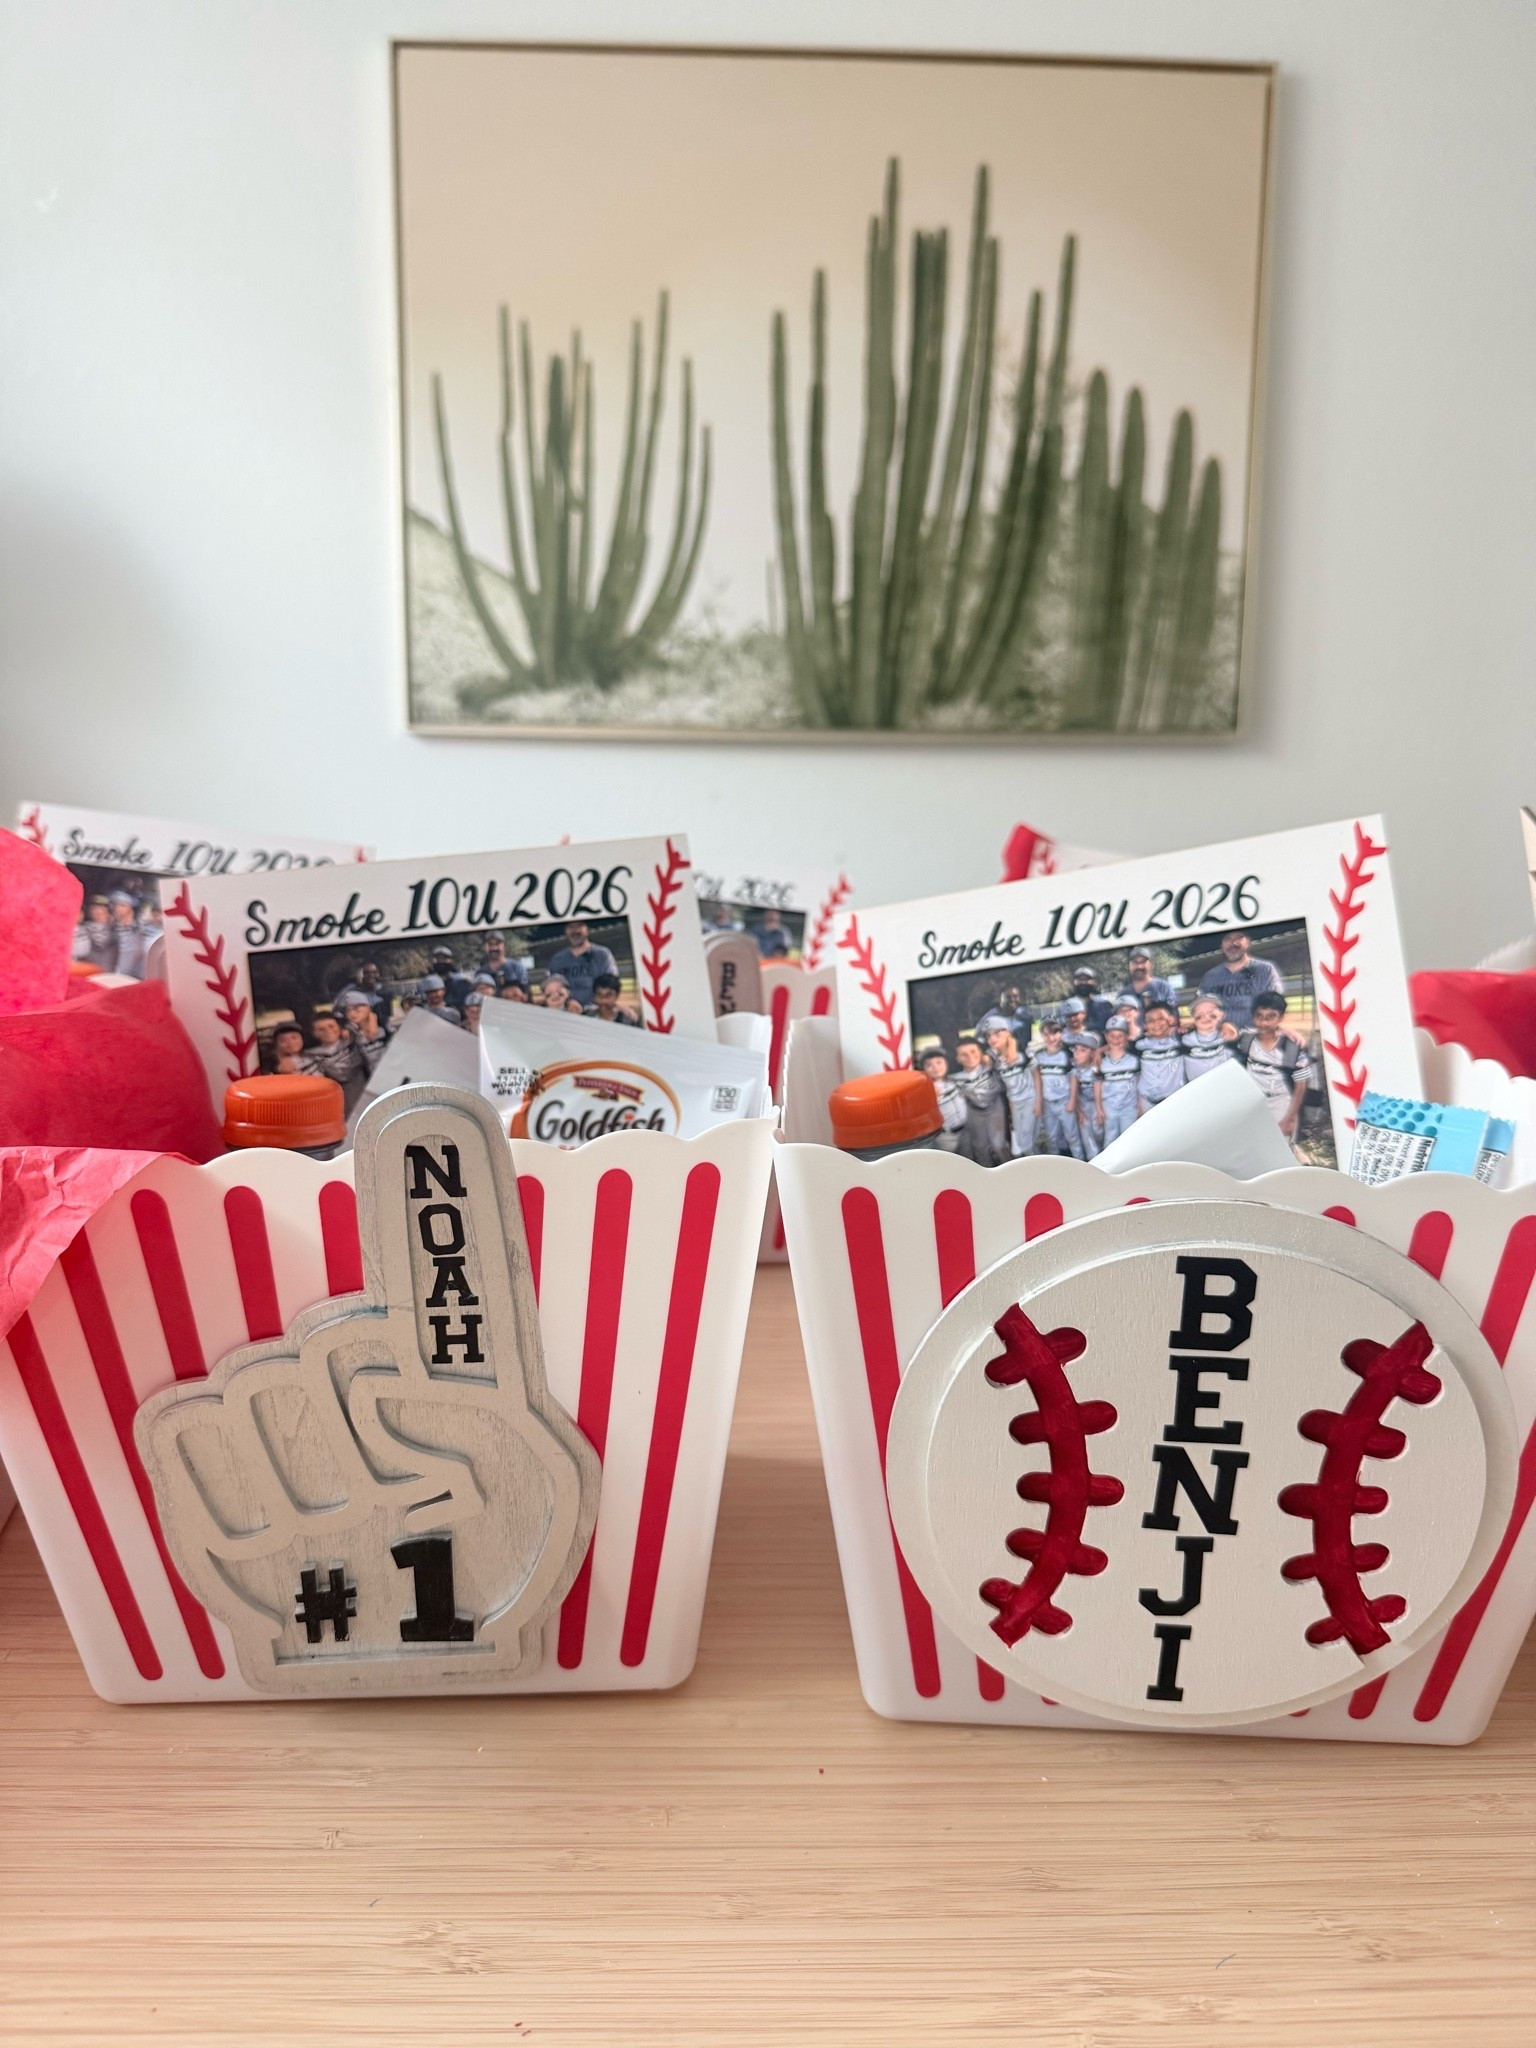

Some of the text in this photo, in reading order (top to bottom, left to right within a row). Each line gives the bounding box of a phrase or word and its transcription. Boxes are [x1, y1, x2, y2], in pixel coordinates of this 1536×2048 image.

[62, 828, 153, 866] Smoke
[245, 892, 390, 948] Smoke
[401, 877, 499, 932] 10U
[508, 865, 632, 922] 2026
[919, 875, 1259, 967] Smoke 10U 2026
[535, 1099, 665, 1141] Goldfish
[405, 1144, 485, 1365] NOAH
[1139, 1255, 1258, 1702] BENJI
